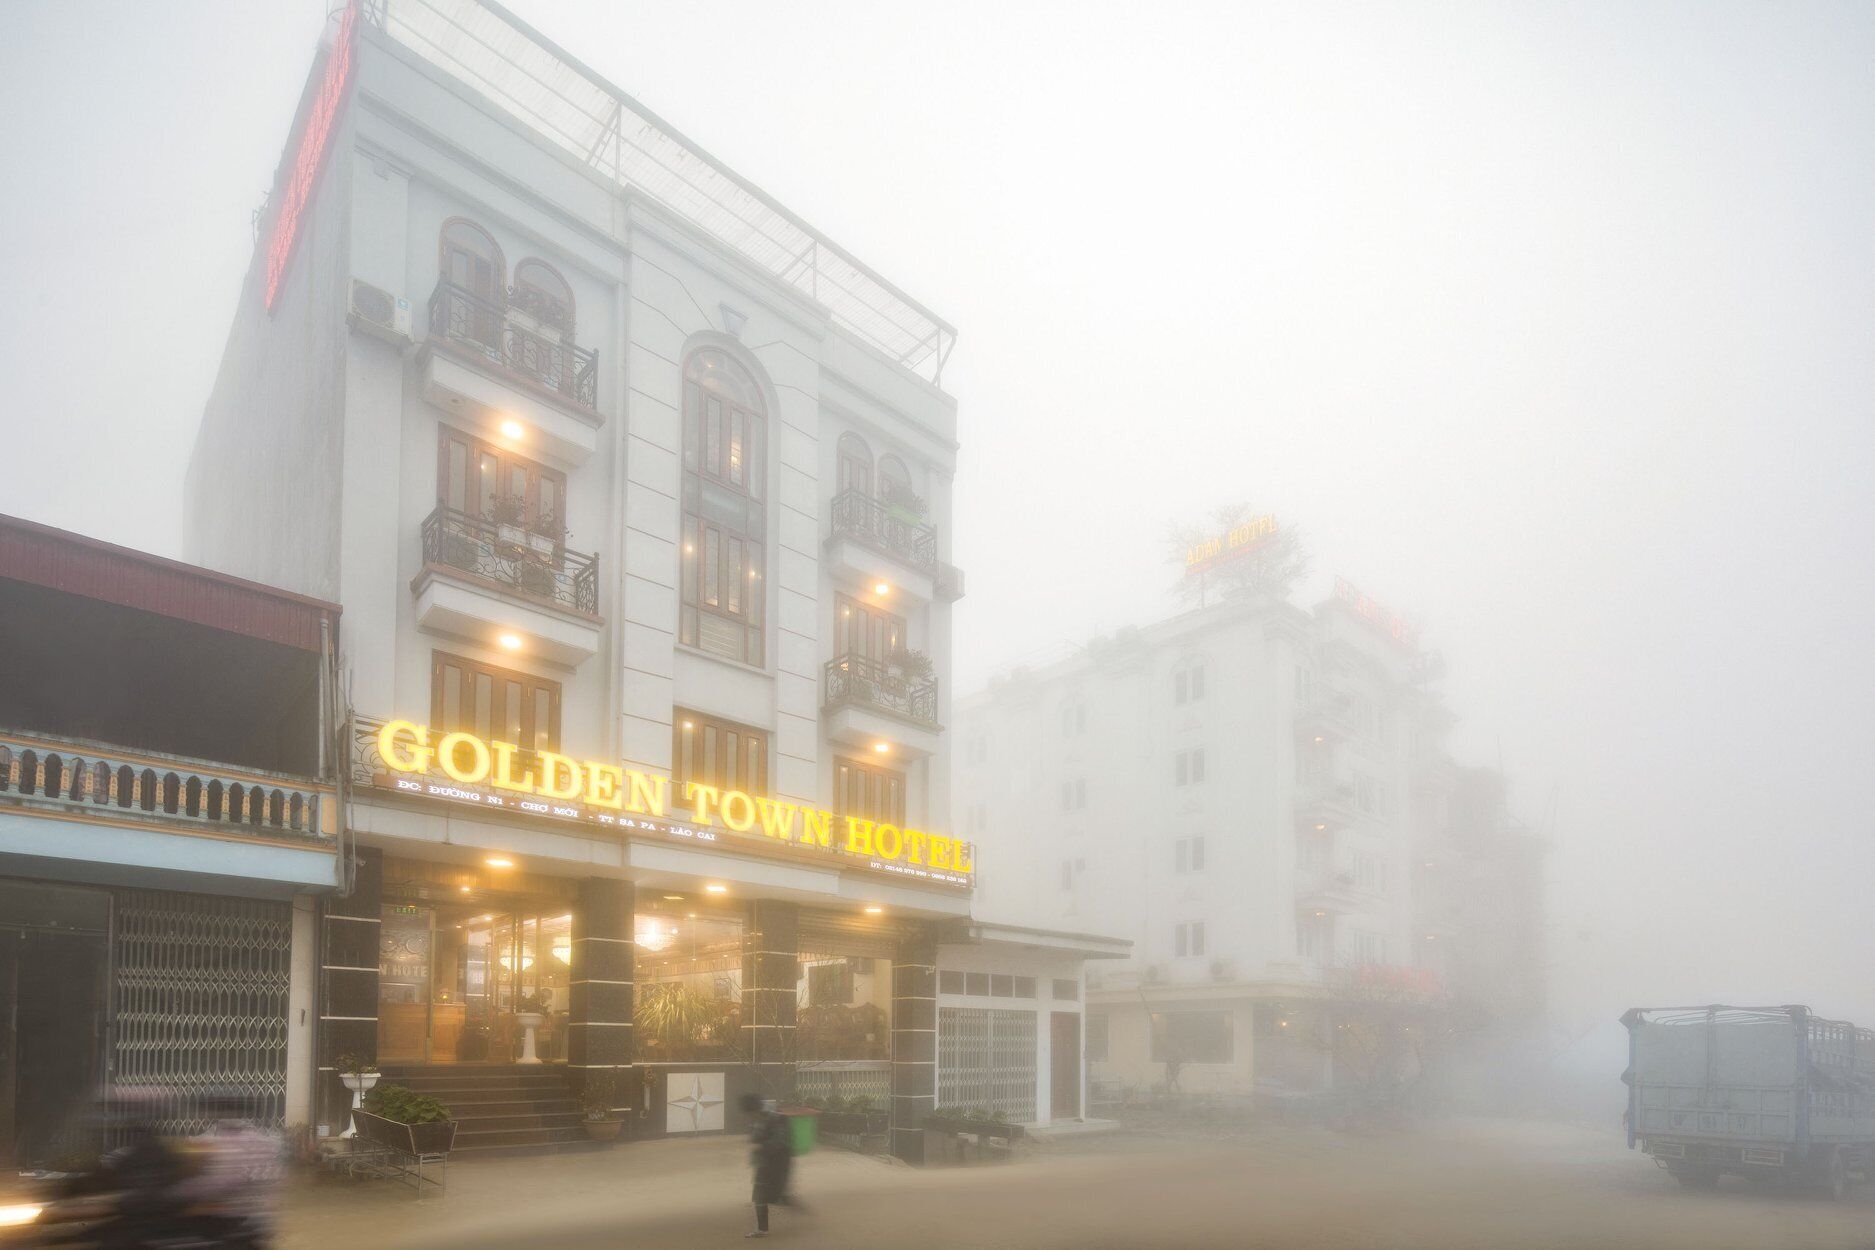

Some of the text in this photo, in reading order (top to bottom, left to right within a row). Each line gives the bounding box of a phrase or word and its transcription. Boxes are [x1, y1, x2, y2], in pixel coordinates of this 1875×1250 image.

[377, 719, 971, 873] GOLDEN TOWN HOTEL
[487, 795, 503, 805] N1
[520, 801, 549, 813] CHỢ
[599, 814, 614, 824] TT
[619, 818, 635, 827] SA
[640, 821, 656, 831] PA
[697, 831, 716, 841] CAI
[393, 963, 428, 977] HOTE
